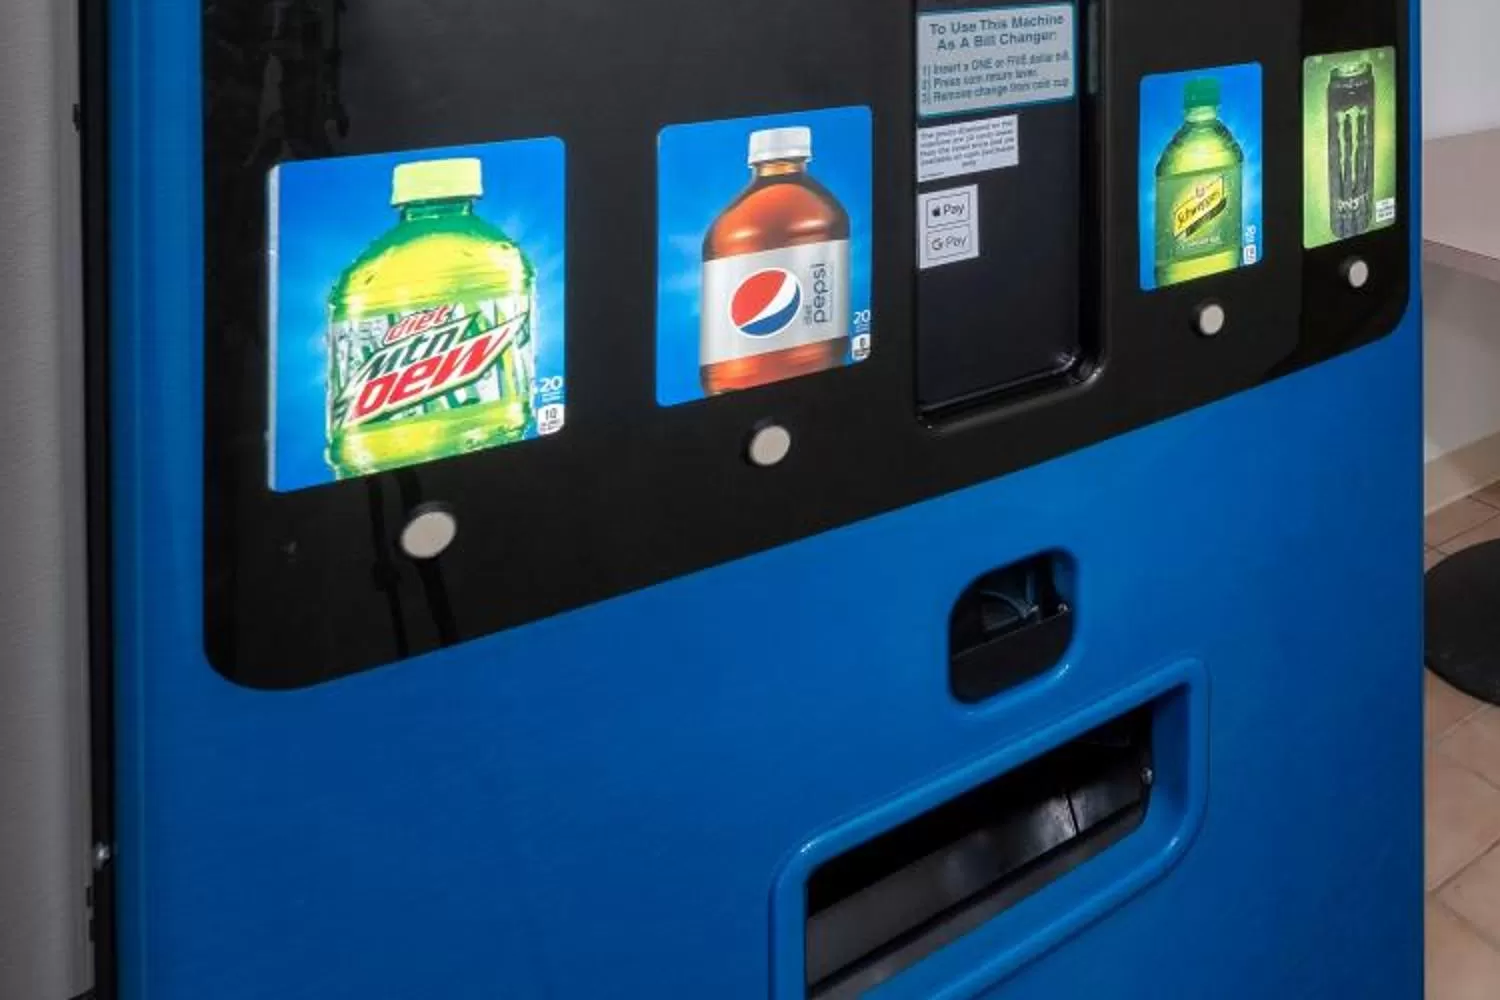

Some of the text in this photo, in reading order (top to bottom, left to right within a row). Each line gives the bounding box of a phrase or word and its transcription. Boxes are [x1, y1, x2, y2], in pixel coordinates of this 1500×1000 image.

[929, 14, 1064, 35] To Use This Machine
[937, 38, 955, 50] As
[960, 37, 970, 48] A
[974, 35, 997, 47] Bill
[972, 58, 994, 70] ONE
[943, 203, 965, 216] Pay
[945, 235, 968, 249] Pay
[811, 263, 829, 323] pepsi
[387, 304, 451, 341] diet
[853, 309, 871, 325] 20
[539, 375, 563, 393] 20
